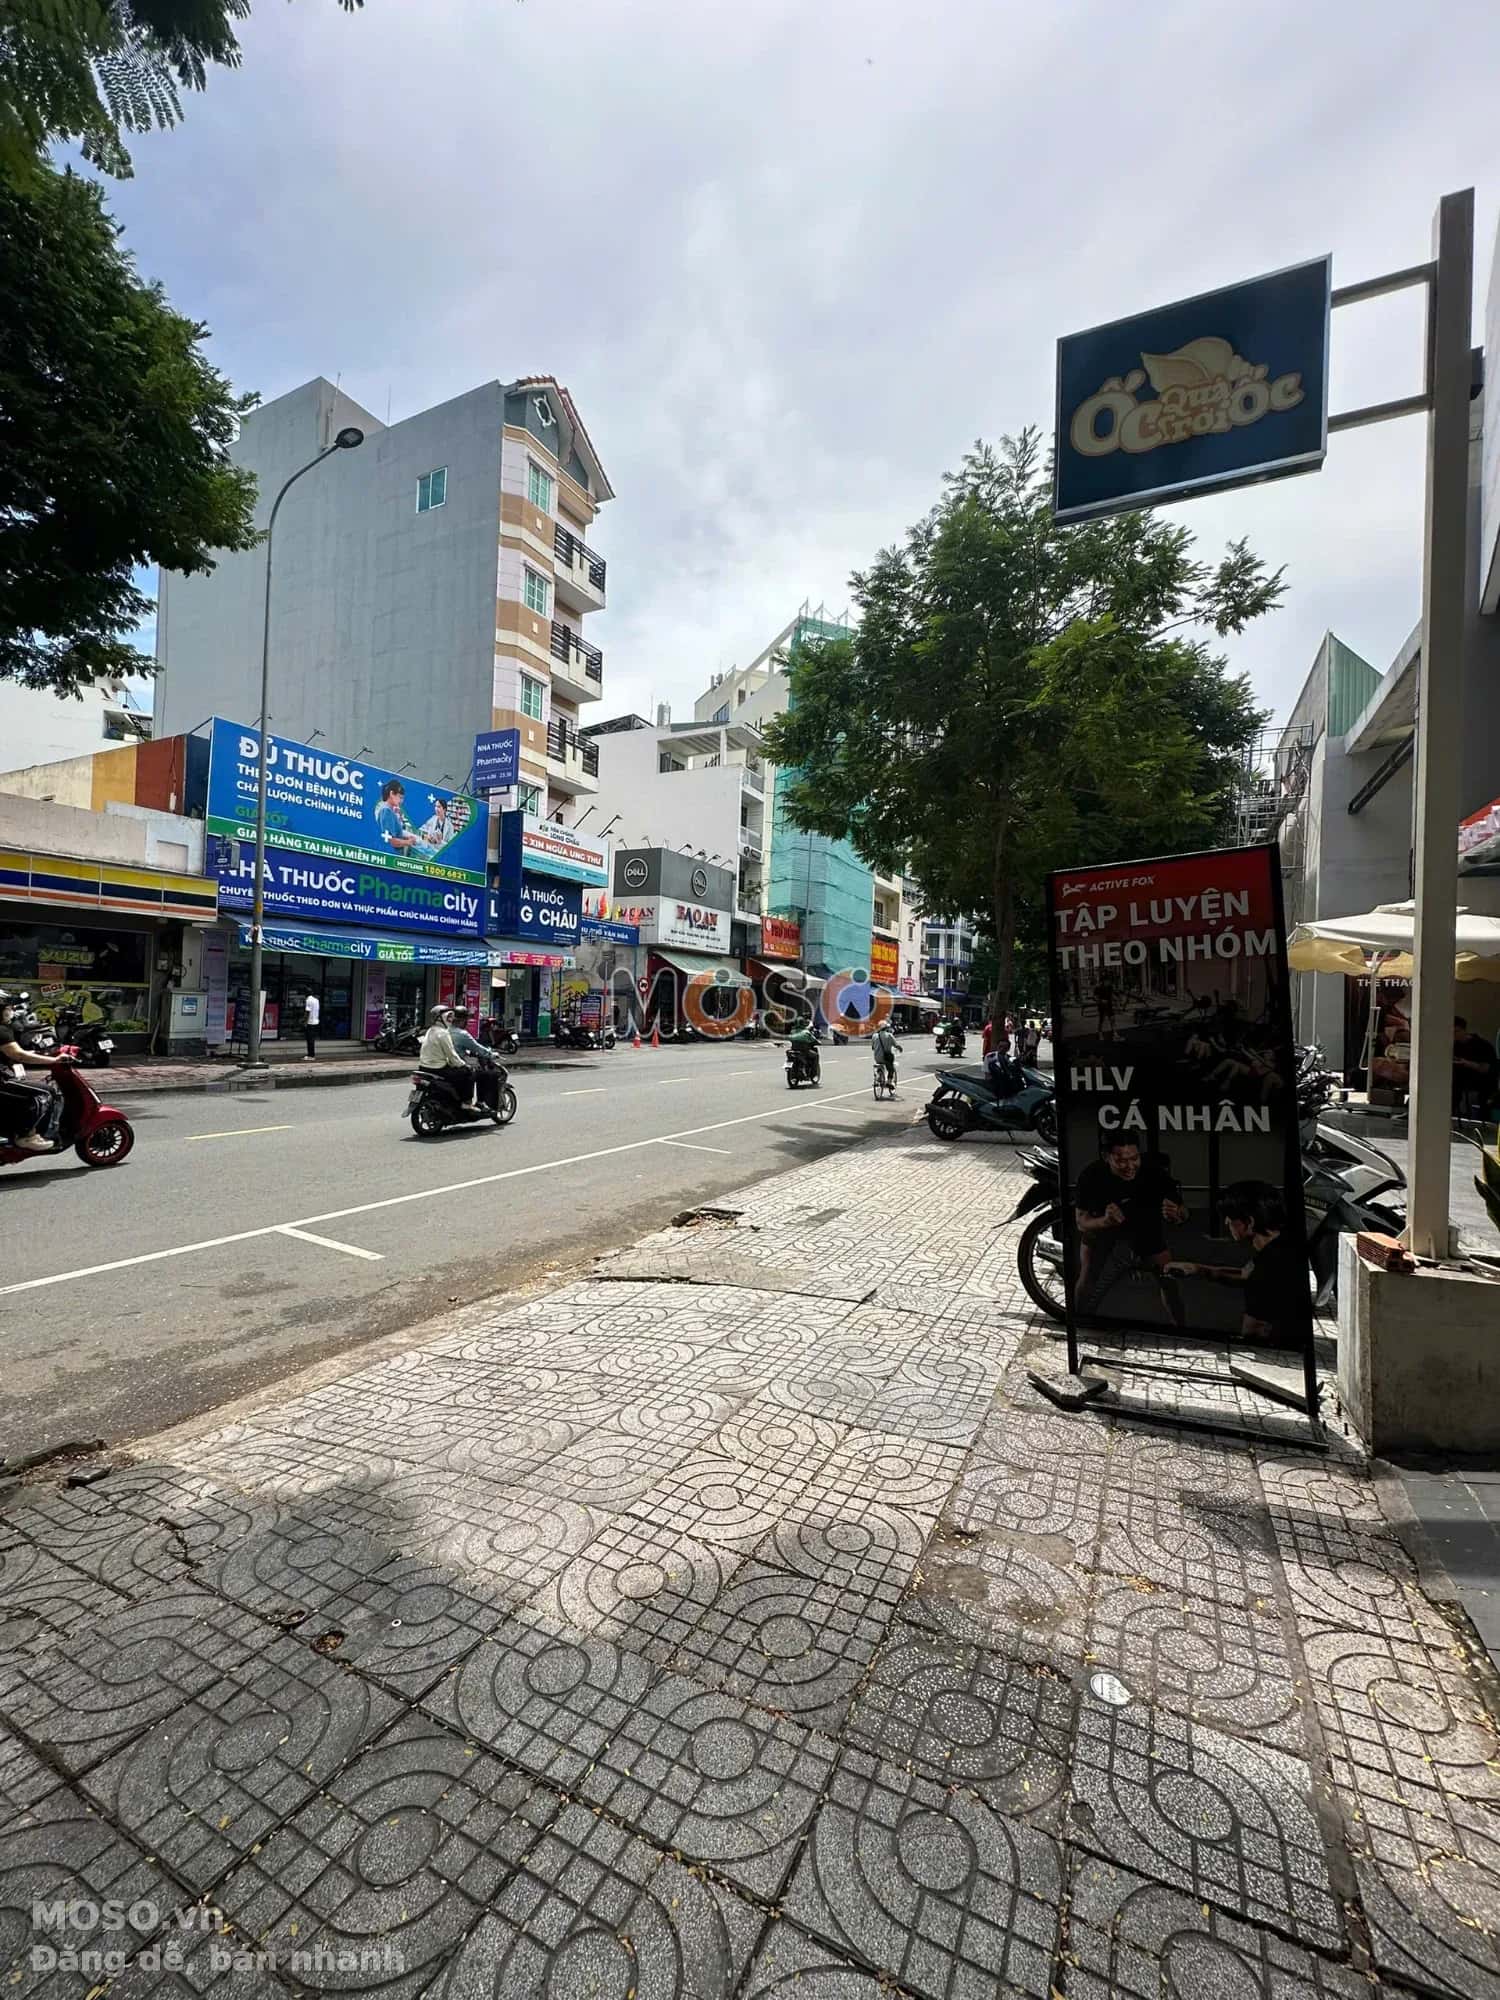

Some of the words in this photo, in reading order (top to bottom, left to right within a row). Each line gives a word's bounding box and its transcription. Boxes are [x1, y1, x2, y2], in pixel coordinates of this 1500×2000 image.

[239, 734, 278, 765] ĐỦ
[283, 749, 364, 790] THUỐC
[267, 788, 303, 805] LƯỢNG
[304, 796, 335, 813] CHÍNH
[336, 806, 363, 820] HÀNG
[274, 774, 304, 791] ĐƠN
[306, 782, 337, 799] BỆNH
[338, 790, 364, 807] VIỆN
[269, 834, 302, 848] HÀNG
[303, 841, 320, 854] TẠI
[321, 845, 343, 856] NHÀ
[345, 848, 369, 862] MIỄN
[371, 854, 386, 865] PHÍ
[626, 867, 645, 877] DELL
[1088, 878, 1129, 892] ACTIVE
[1131, 874, 1156, 888] FOX
[263, 891, 295, 903] THUỐC
[296, 896, 320, 906] THEO
[278, 866, 356, 895] THUỐC
[358, 874, 479, 918] Pharmacity
[531, 889, 564, 906] THUỐC
[539, 908, 577, 929] CHÂU
[1054, 901, 1118, 937] TẬP
[1129, 887, 1250, 926] LUYỆN
[378, 949, 395, 960] GIÁ
[1055, 939, 1147, 971] THEO
[1159, 925, 1278, 962] NHÓM
[1070, 1066, 1135, 1092] HLV
[1098, 1098, 1148, 1131] CÁ
[1157, 1099, 1271, 1133] NHÂN
